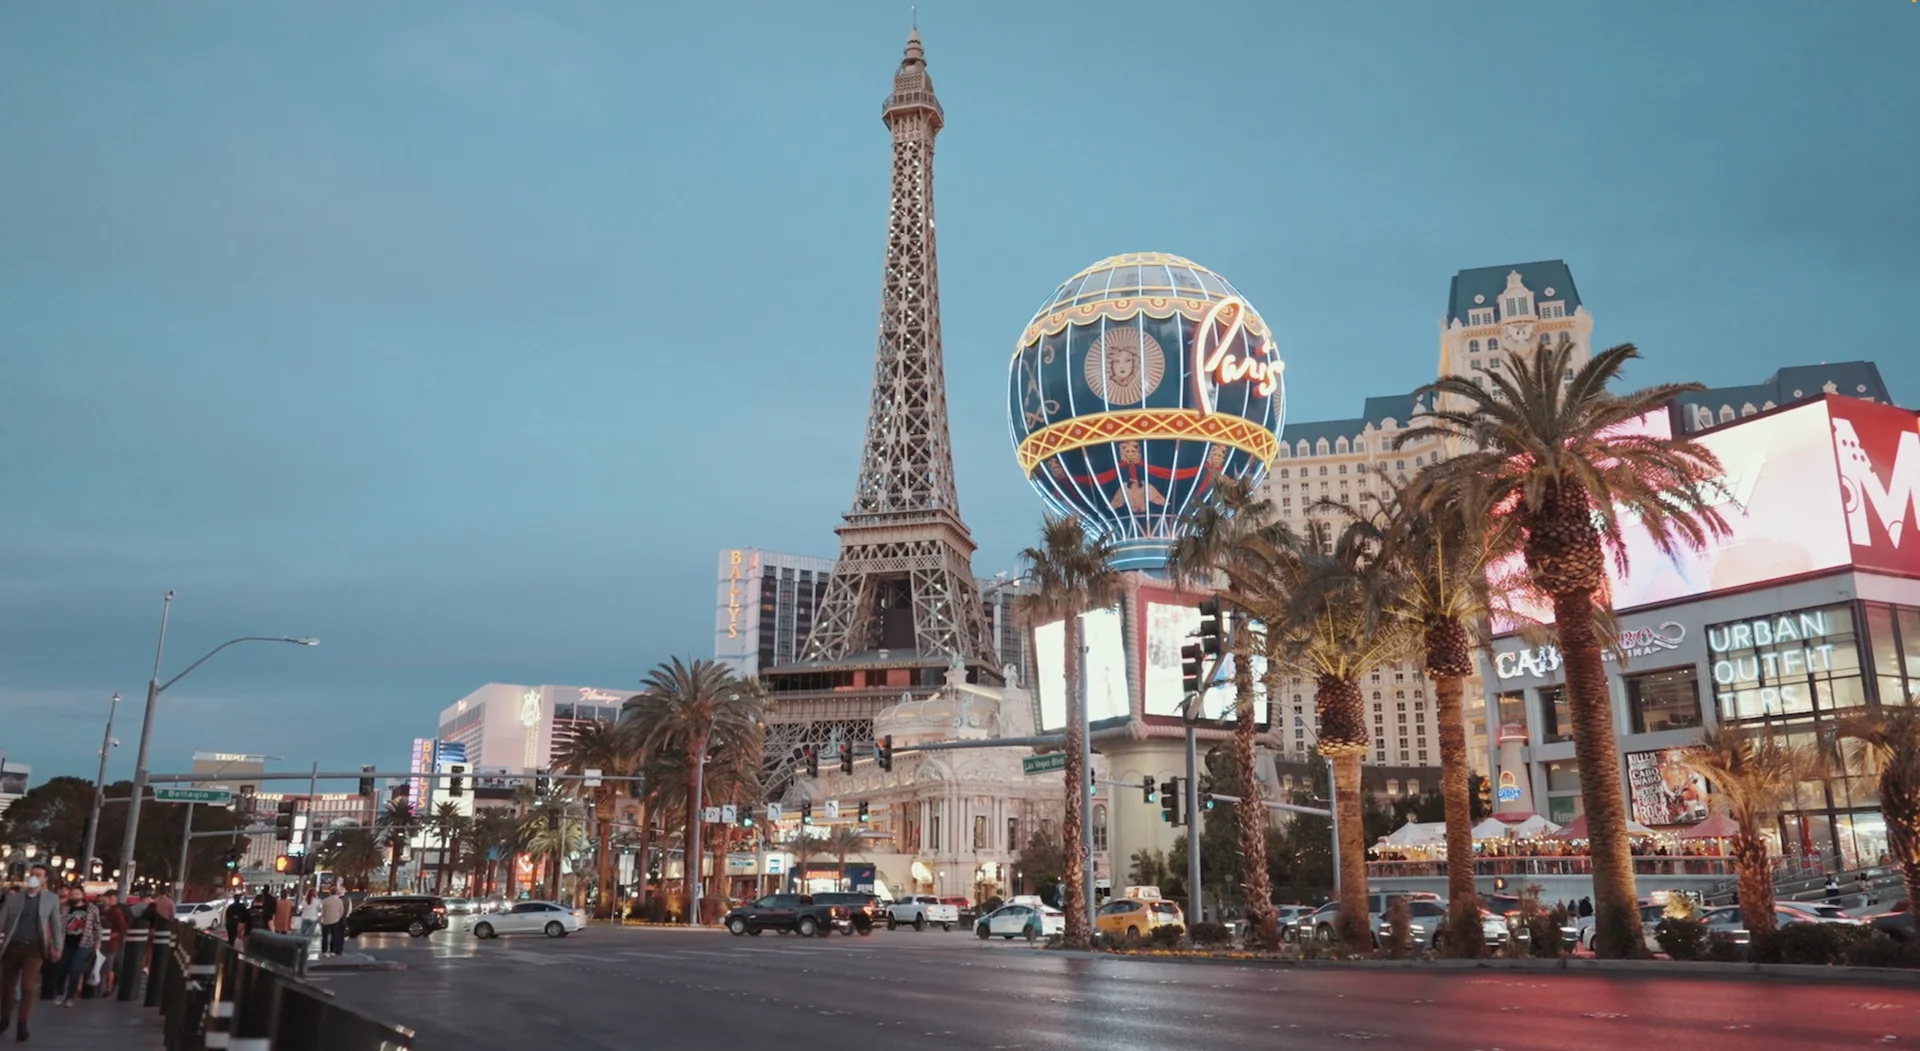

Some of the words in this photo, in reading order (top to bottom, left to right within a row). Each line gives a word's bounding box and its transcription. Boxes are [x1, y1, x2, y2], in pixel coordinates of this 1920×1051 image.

[1196, 296, 1285, 416] Paris
[1708, 610, 1825, 653] URBAN
[1495, 645, 1564, 679] CAB
[1713, 643, 1833, 685] OUTFIT
[578, 687, 621, 704] Flamingo
[1717, 685, 1799, 717] TERS
[214, 753, 246, 762] TRUMP
[1627, 752, 1657, 765] KILLER
[1632, 768, 1659, 779] CABO
[1633, 775, 1661, 787] WABO
[168, 790, 209, 800] Bellagio
[1640, 802, 1670, 818] ROCK
